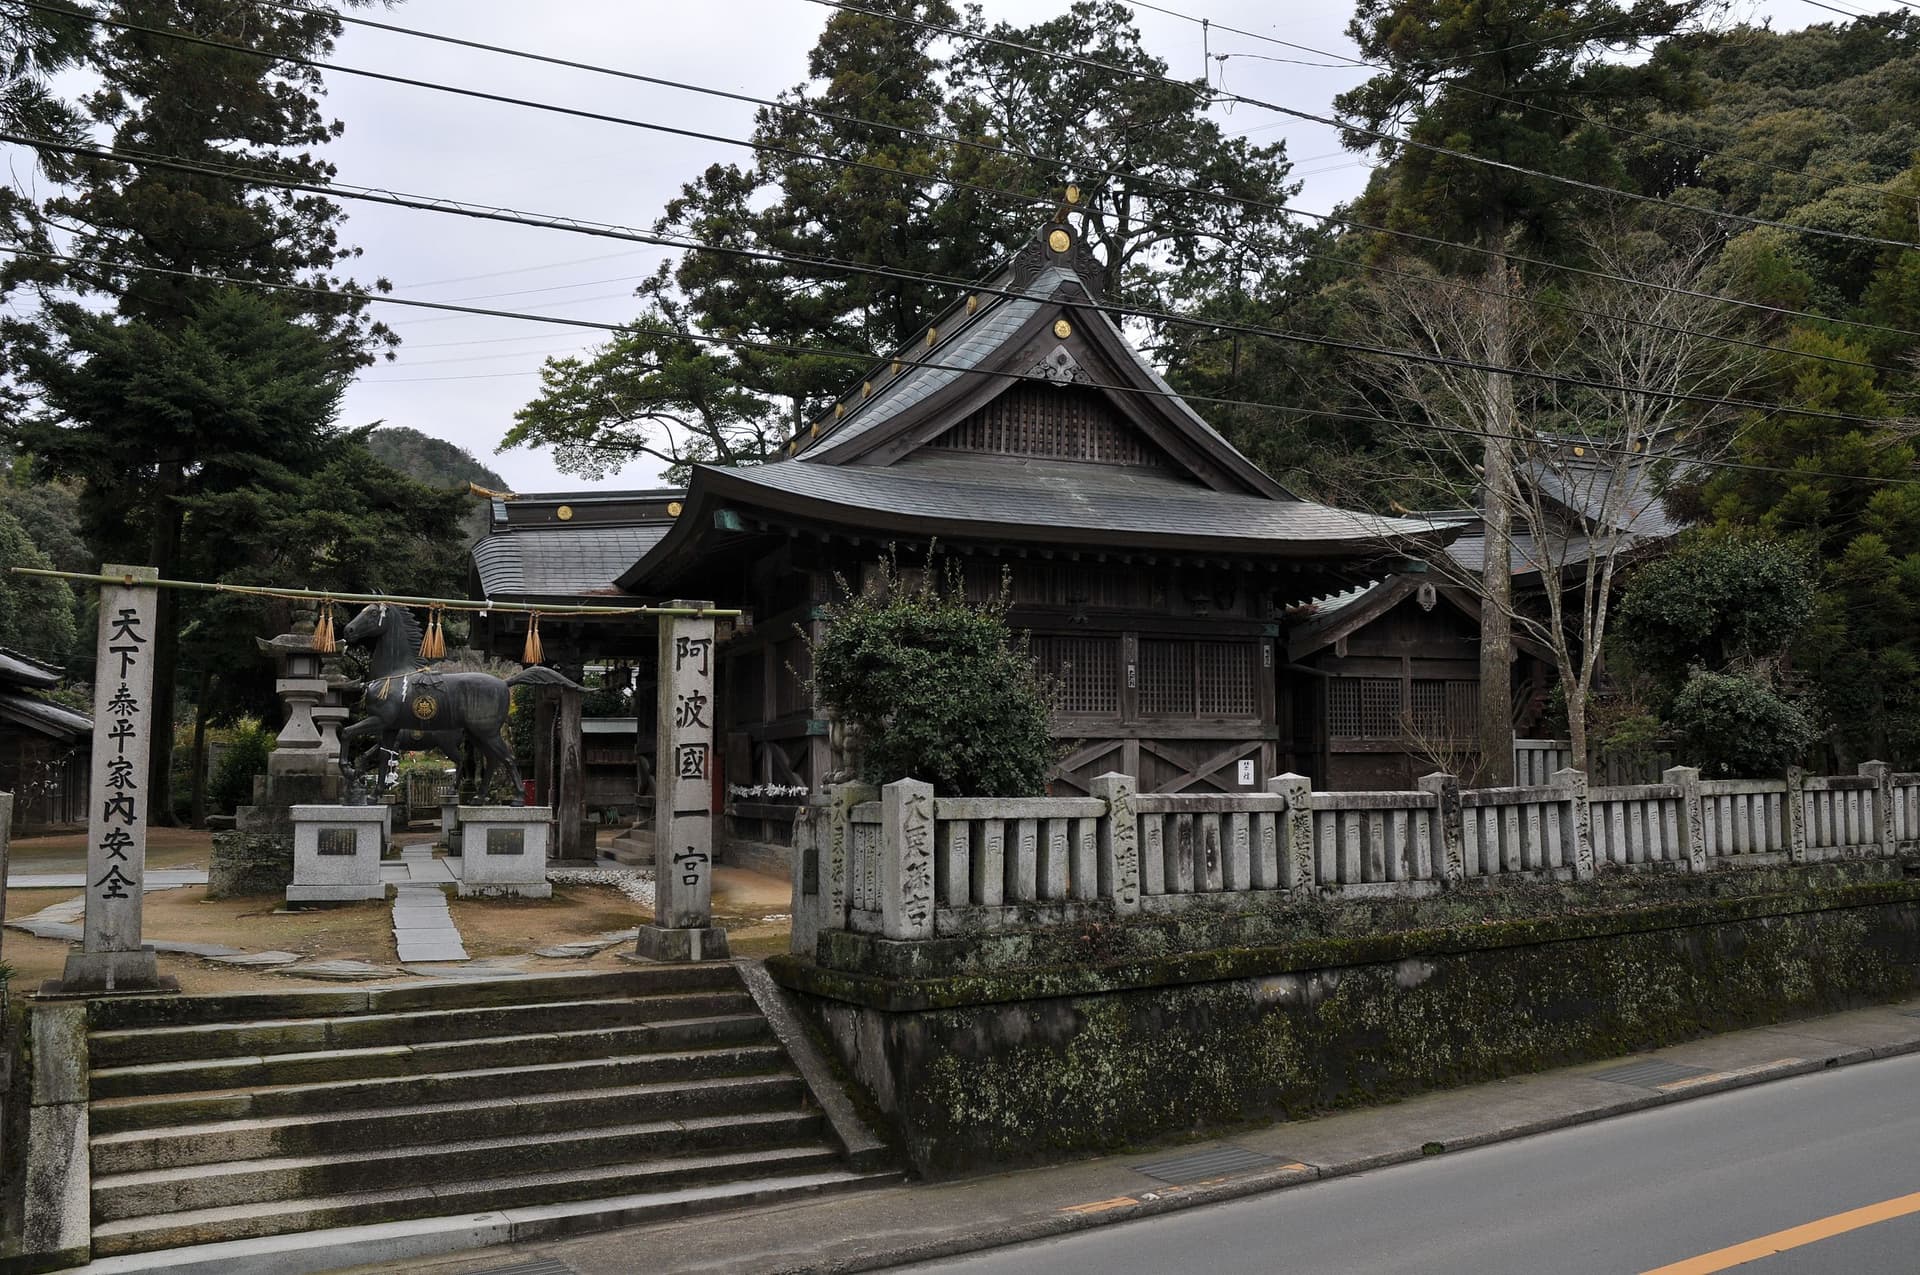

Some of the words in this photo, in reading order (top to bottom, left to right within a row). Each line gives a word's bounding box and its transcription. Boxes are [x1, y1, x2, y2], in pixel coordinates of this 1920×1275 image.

[94, 608, 147, 900] 天下泰平家内安全
[672, 635, 713, 887] 阿波國一宮
